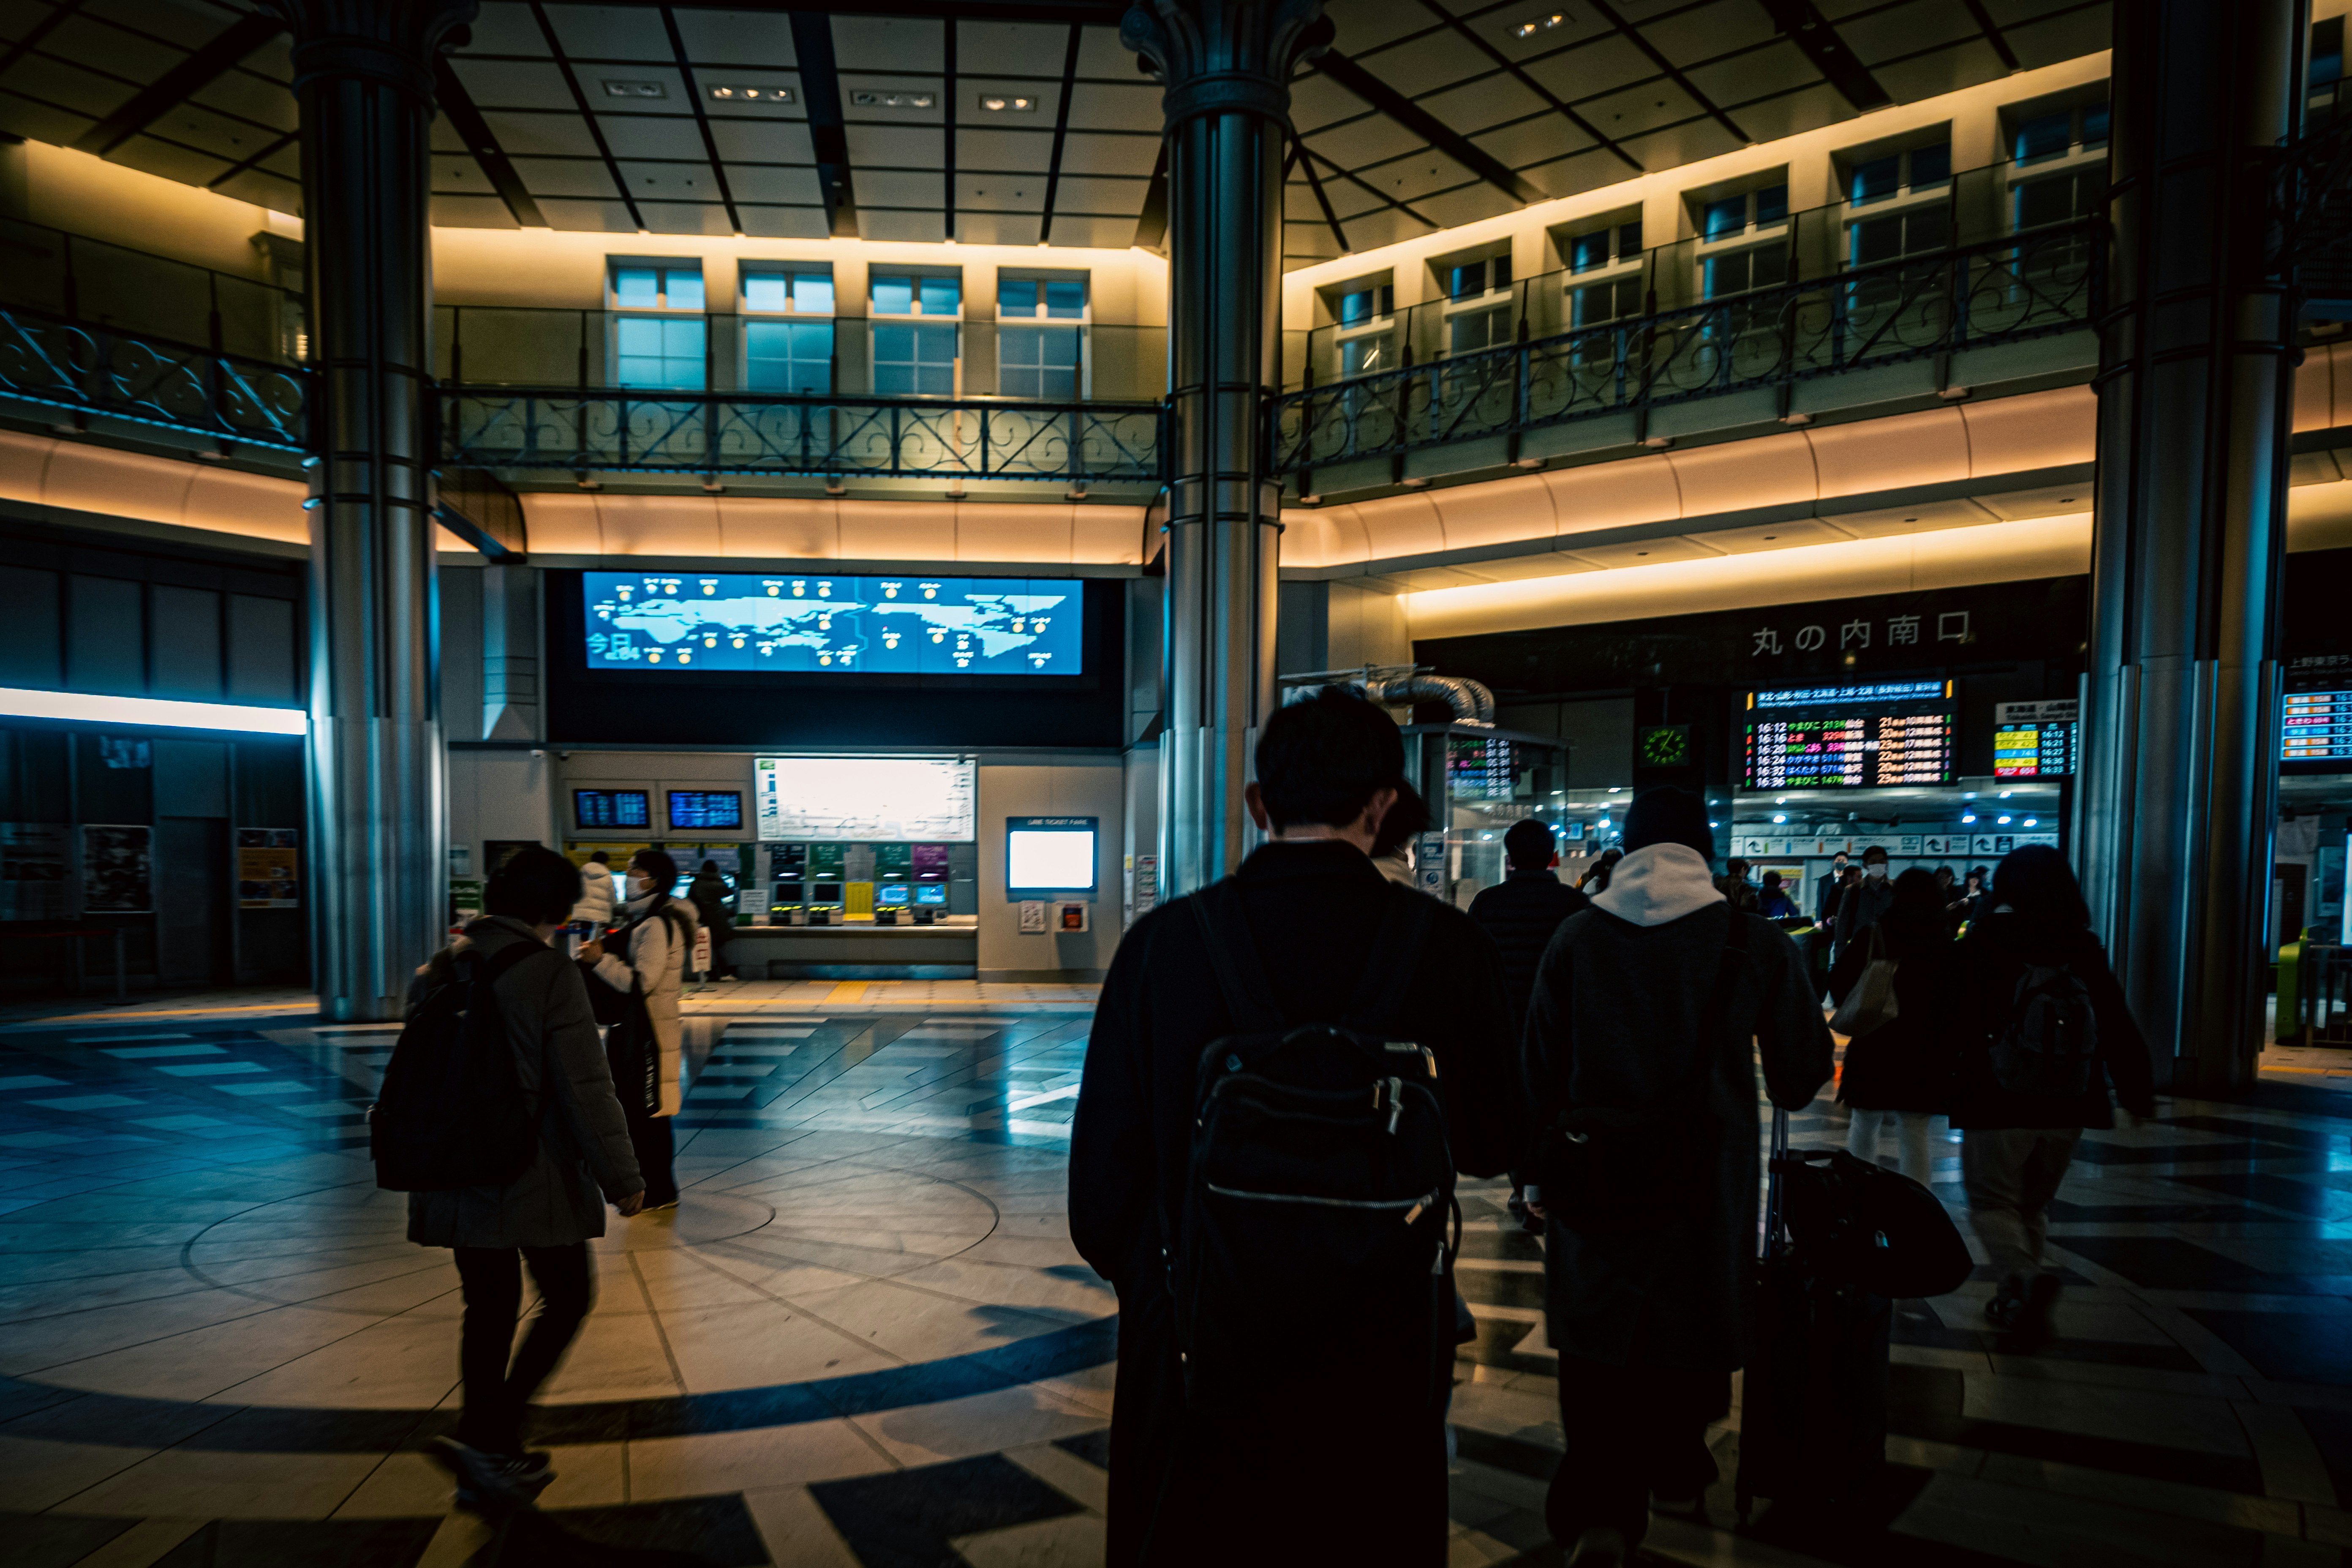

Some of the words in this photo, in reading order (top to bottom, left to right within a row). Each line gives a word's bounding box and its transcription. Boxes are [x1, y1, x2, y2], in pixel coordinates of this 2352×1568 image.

[1752, 610, 1971, 657] 丸の内南口
[2289, 655, 2352, 668] 上野東京ラ
[1757, 722, 1787, 734] 16:12
[1787, 721, 1821, 732] やまびこ
[1757, 733, 1787, 744] 16:16
[2041, 730, 2064, 739] 16:12
[2041, 739, 2063, 748] 16:21
[1757, 744, 1787, 756] 16:20
[2041, 748, 2064, 757] 16:27
[1757, 755, 1786, 766] 16:24
[2041, 757, 2064, 765] 16:30
[1756, 766, 1786, 777] 16:32
[1785, 765, 1820, 775] はくたか
[2041, 766, 2064, 774] 16:33
[1756, 777, 1786, 788] 16:36
[1786, 776, 1819, 787] やまびこ
